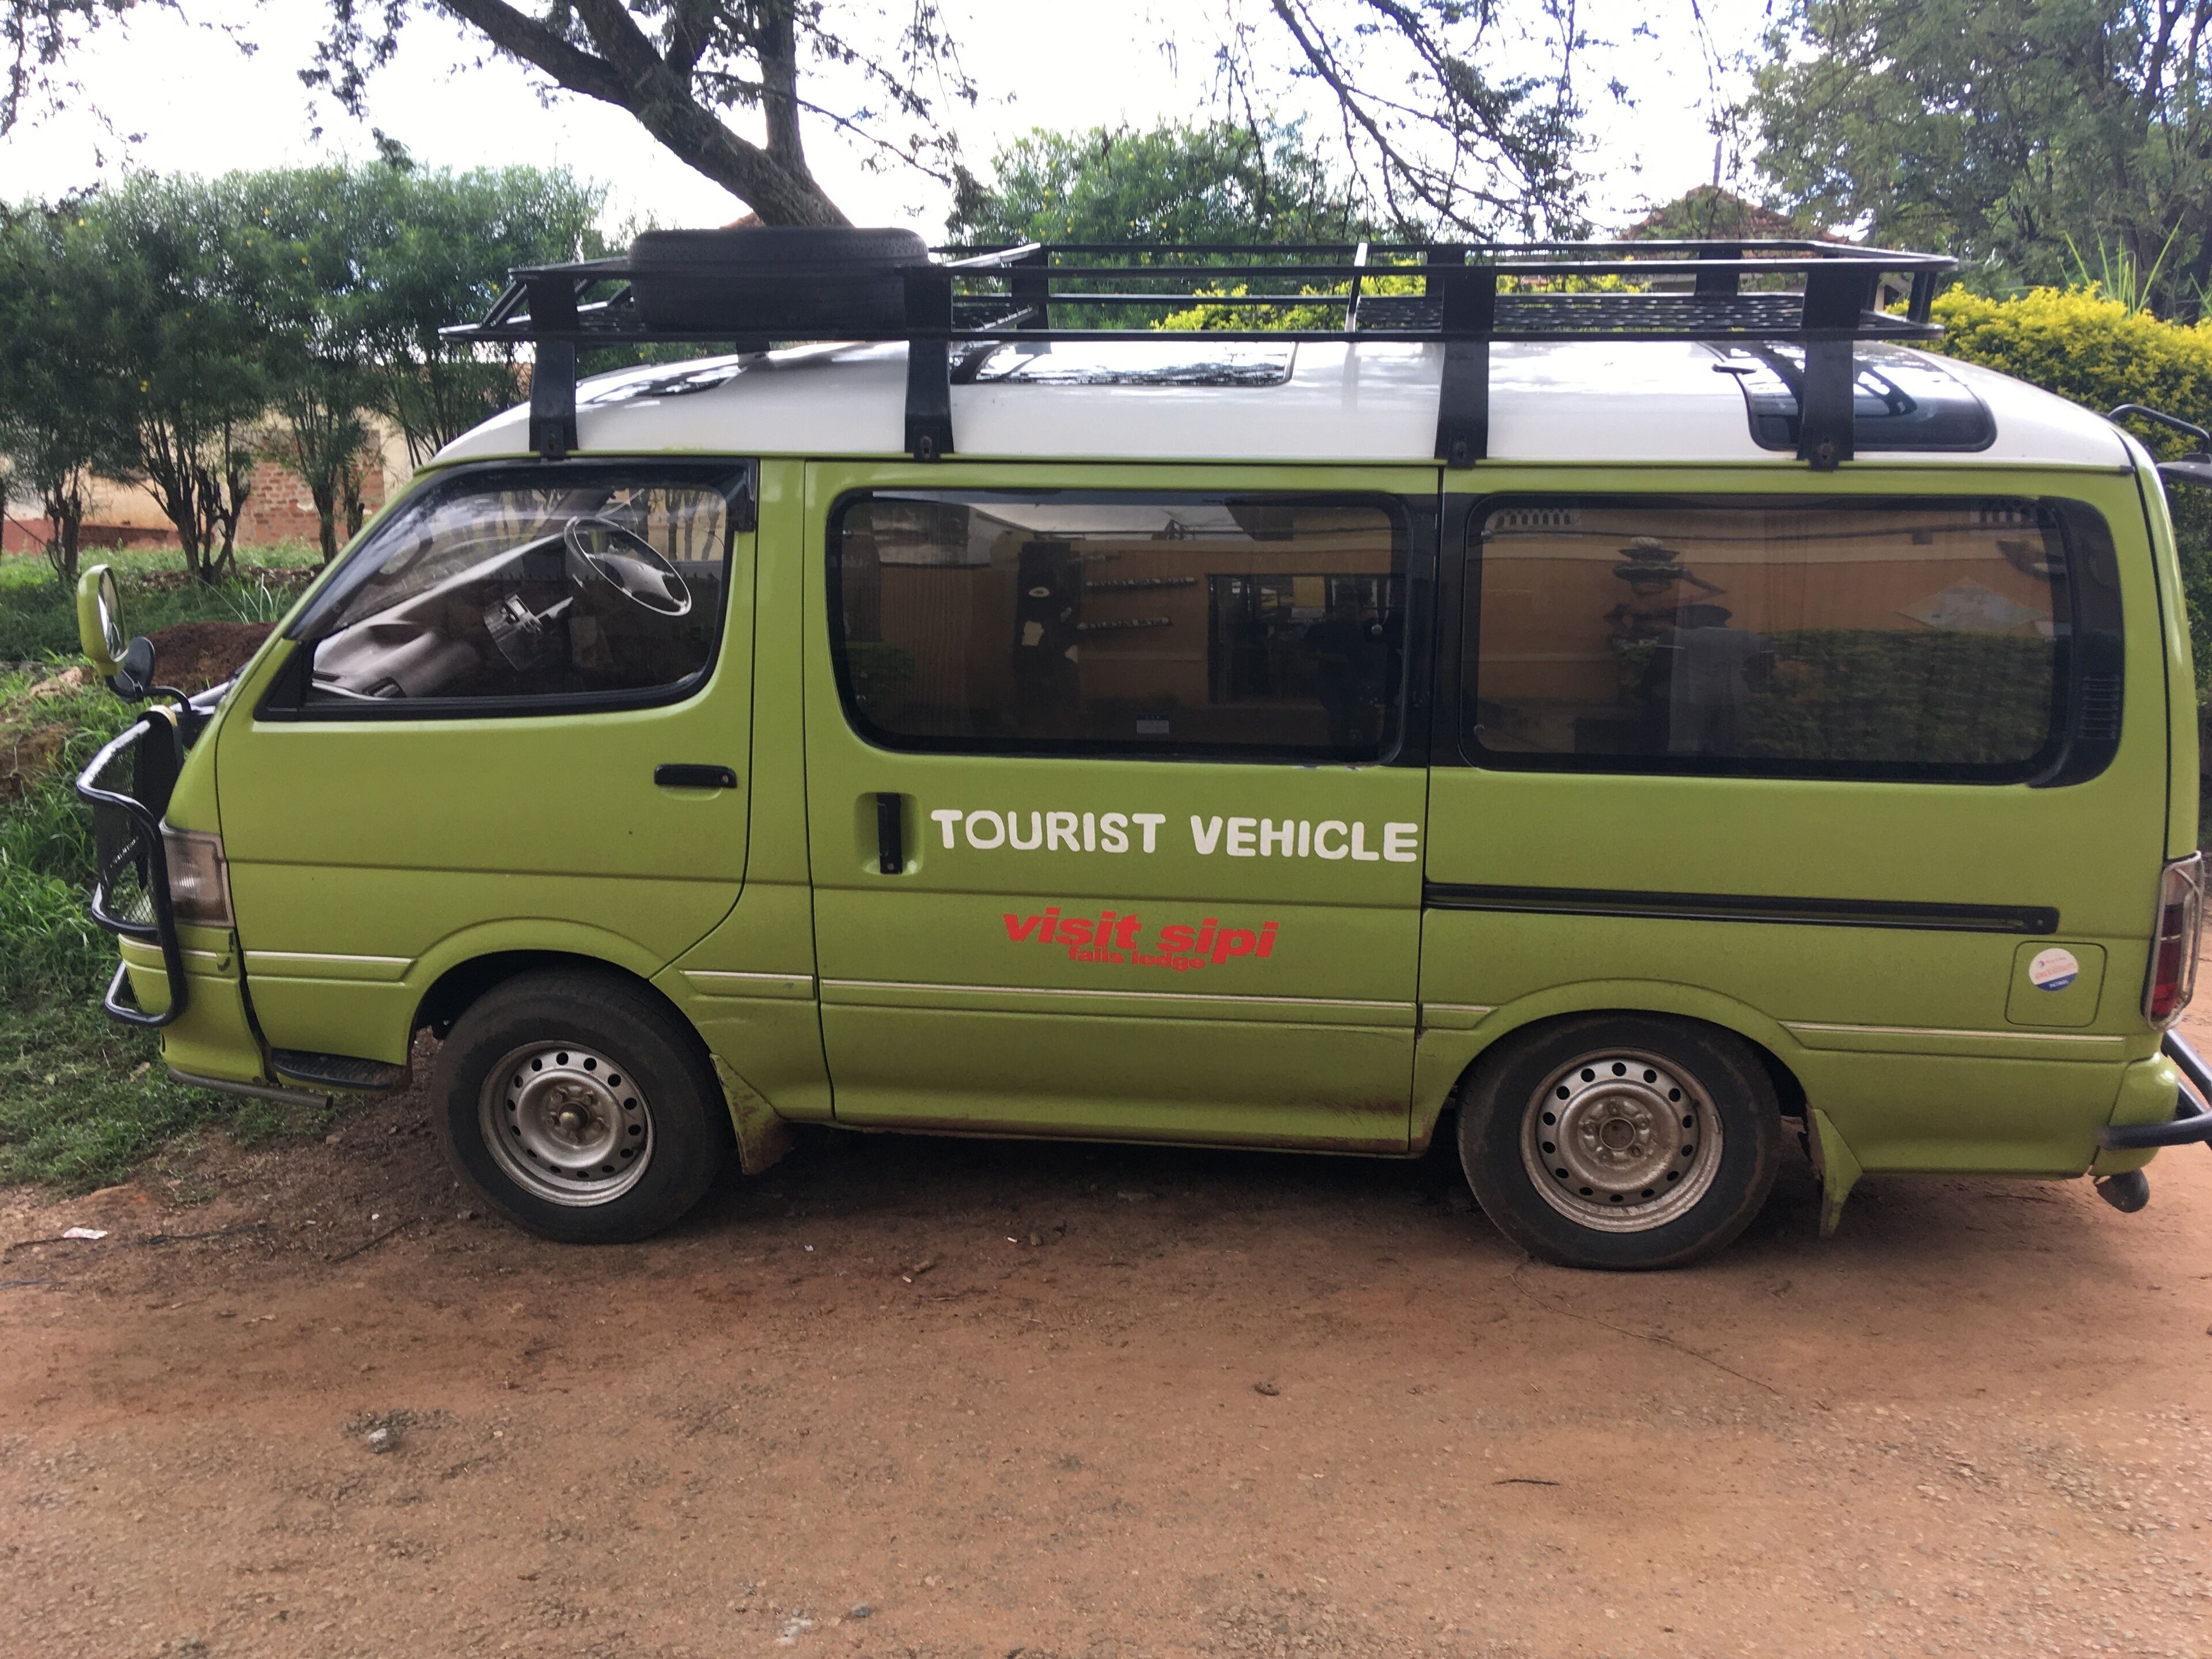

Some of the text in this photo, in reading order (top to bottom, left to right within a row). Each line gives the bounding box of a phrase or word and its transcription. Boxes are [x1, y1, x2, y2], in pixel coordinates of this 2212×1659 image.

[931, 809, 1418, 862] TOURIST VEHICLE
[1003, 907, 1281, 965] visit sipi
[1069, 945, 1206, 972] falls lodge
